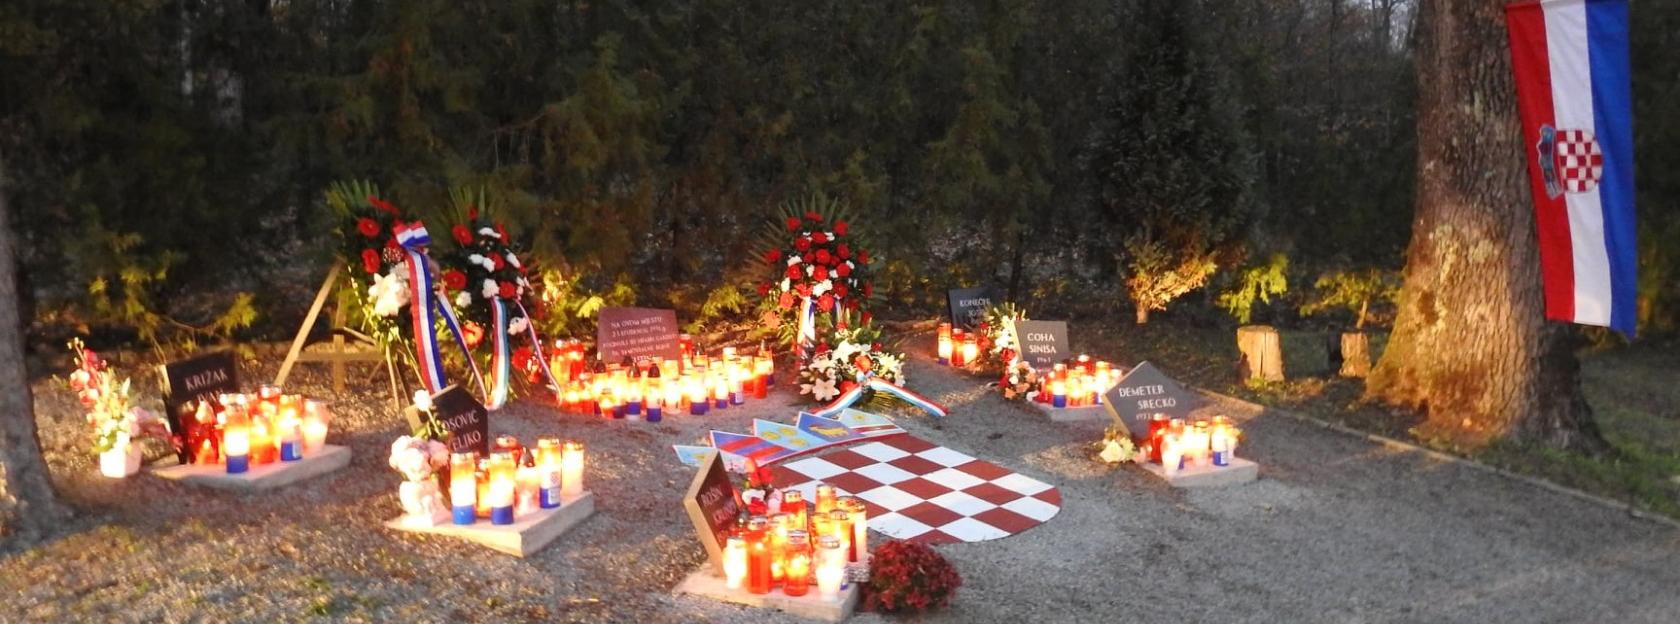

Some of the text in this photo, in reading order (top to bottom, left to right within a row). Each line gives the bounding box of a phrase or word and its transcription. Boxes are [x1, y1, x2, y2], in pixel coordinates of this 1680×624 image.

[1027, 332, 1055, 342] COHA
[1119, 384, 1165, 398] DEMETER
[452, 430, 481, 452] ELJKO
